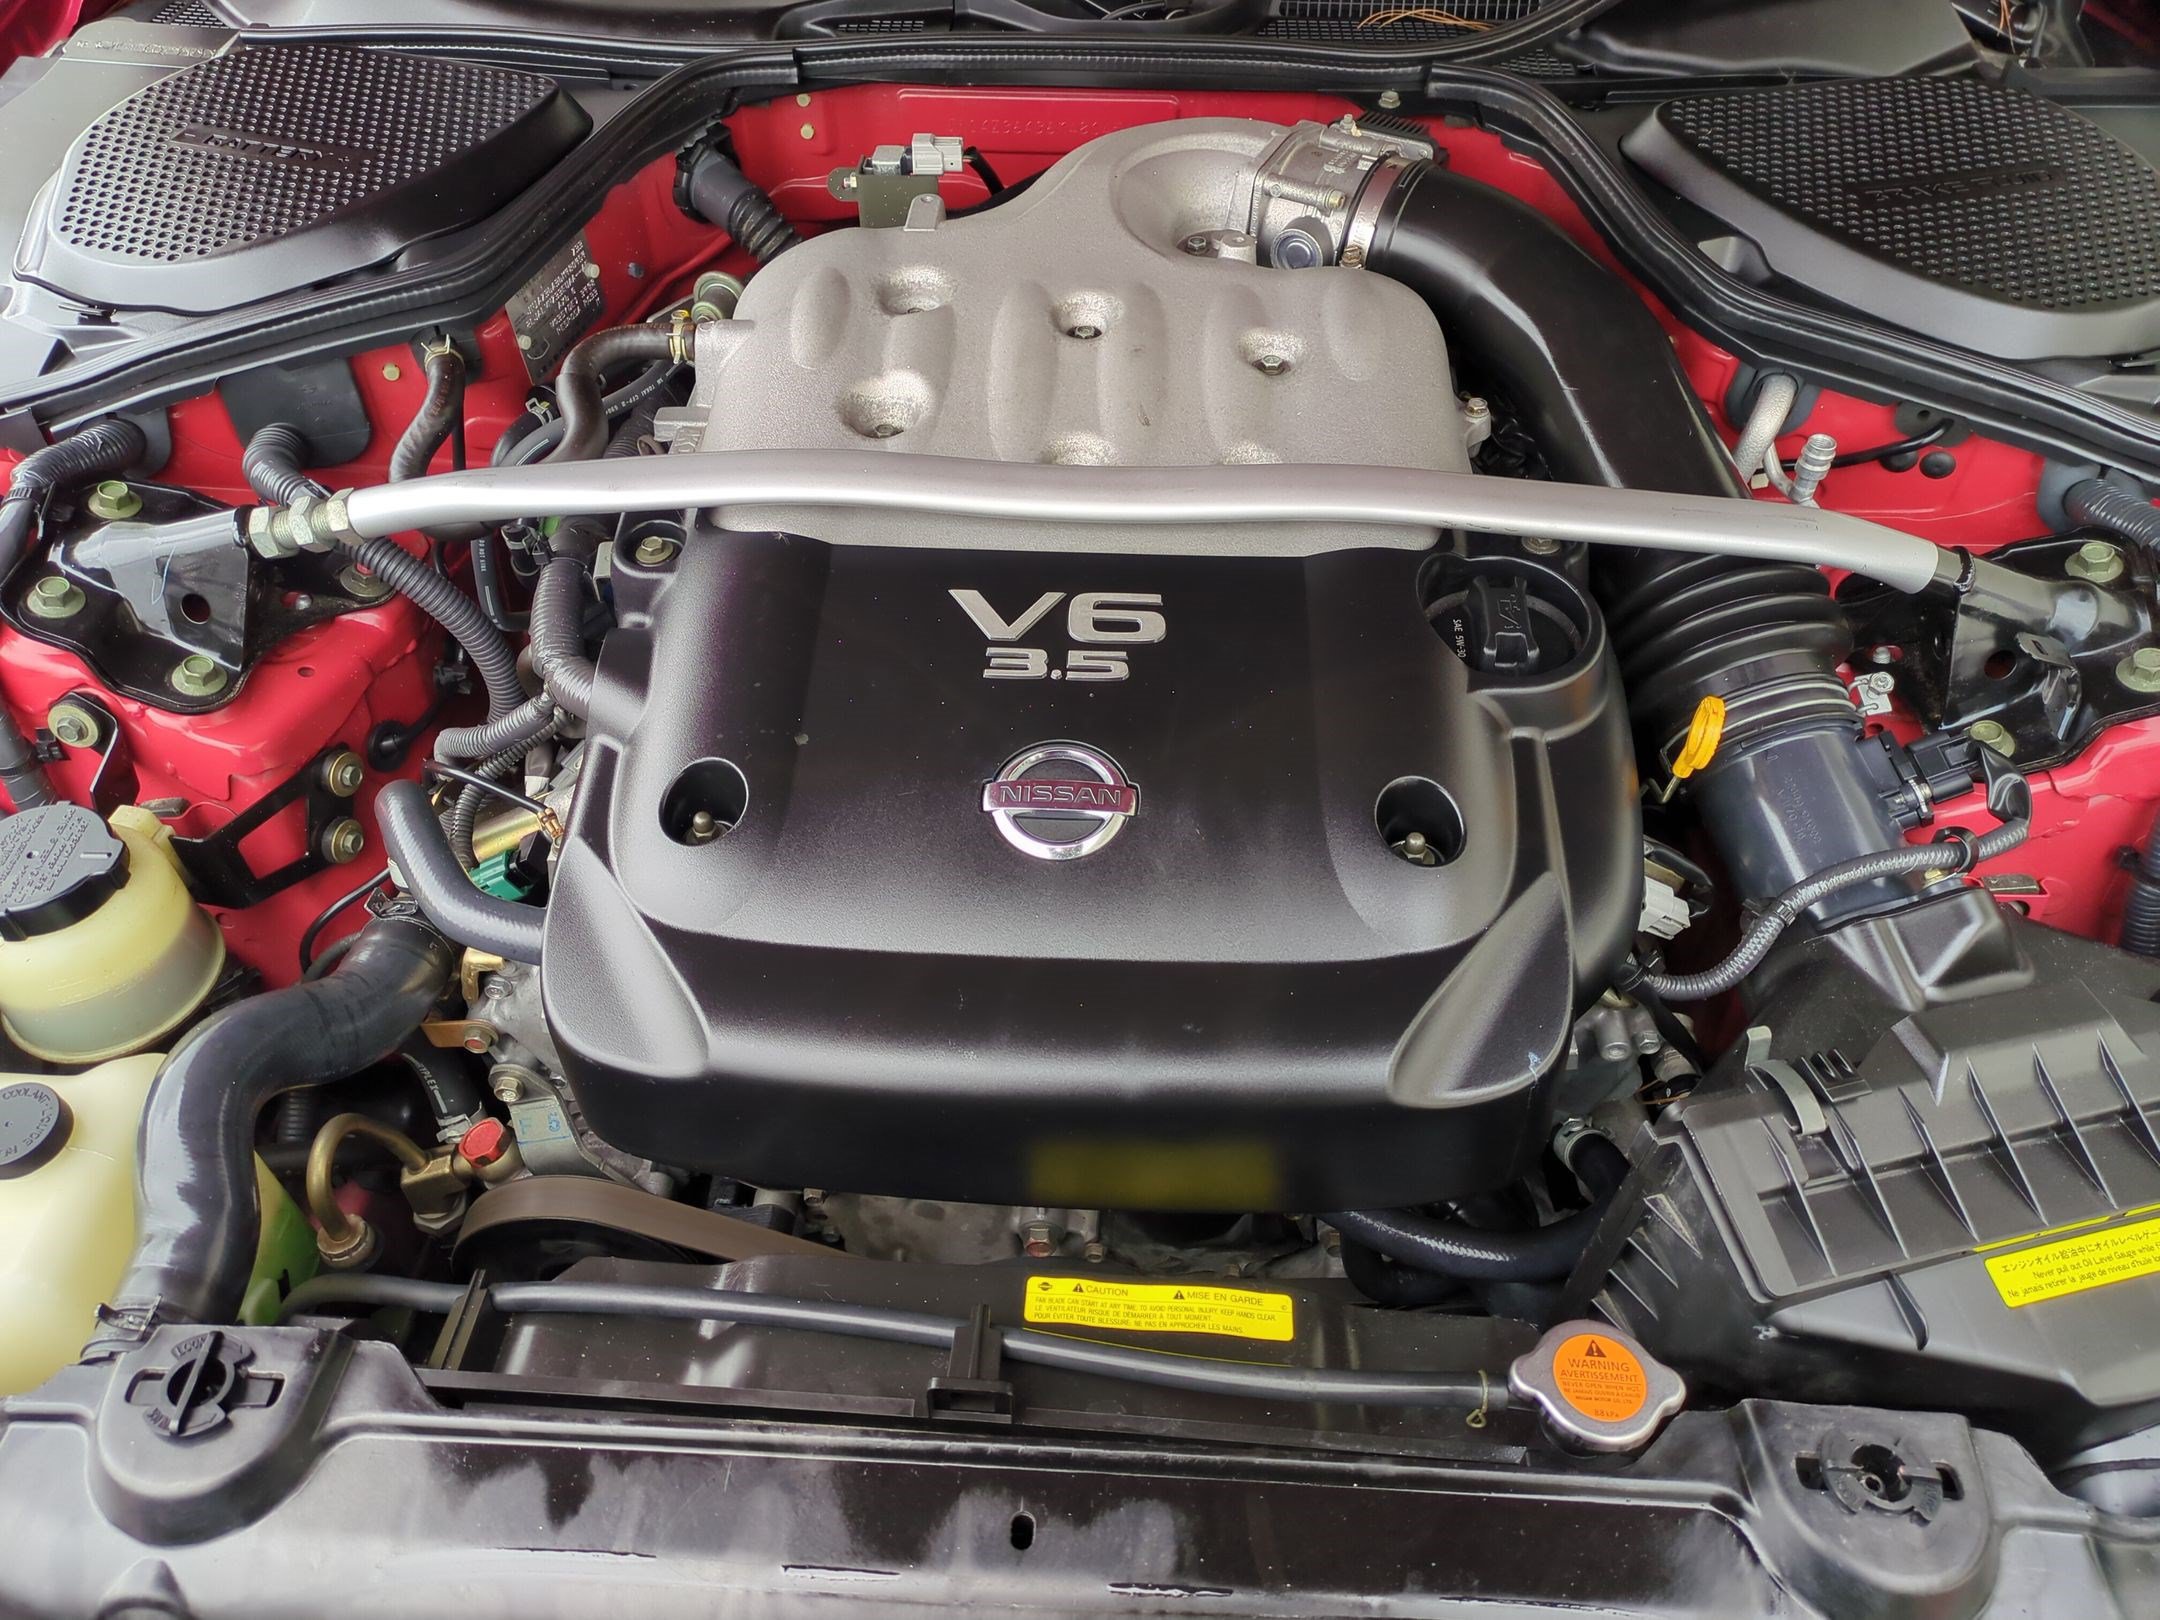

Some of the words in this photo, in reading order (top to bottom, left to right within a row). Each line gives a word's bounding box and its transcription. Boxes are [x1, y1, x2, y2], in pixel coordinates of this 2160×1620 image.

[948, 589, 1167, 644] V6
[1453, 619, 1463, 632] SAE
[983, 646, 1130, 682] 3.5
[1000, 785, 1121, 807] NISSAN
[2002, 1227, 2160, 1273] エンジンオイル給油中にオイルレベルゲー
[2033, 1269, 2054, 1280] Never
[2113, 1249, 2137, 1260] Gauge
[1086, 1285, 1129, 1297] CAUTION
[1186, 1291, 1211, 1301] MISE
[1214, 1293, 1227, 1301] EN
[1231, 1295, 1264, 1306] GARDE
[1567, 1358, 1630, 1372] WARNING
[1560, 1369, 1639, 1383] AVERTISSEMENT
